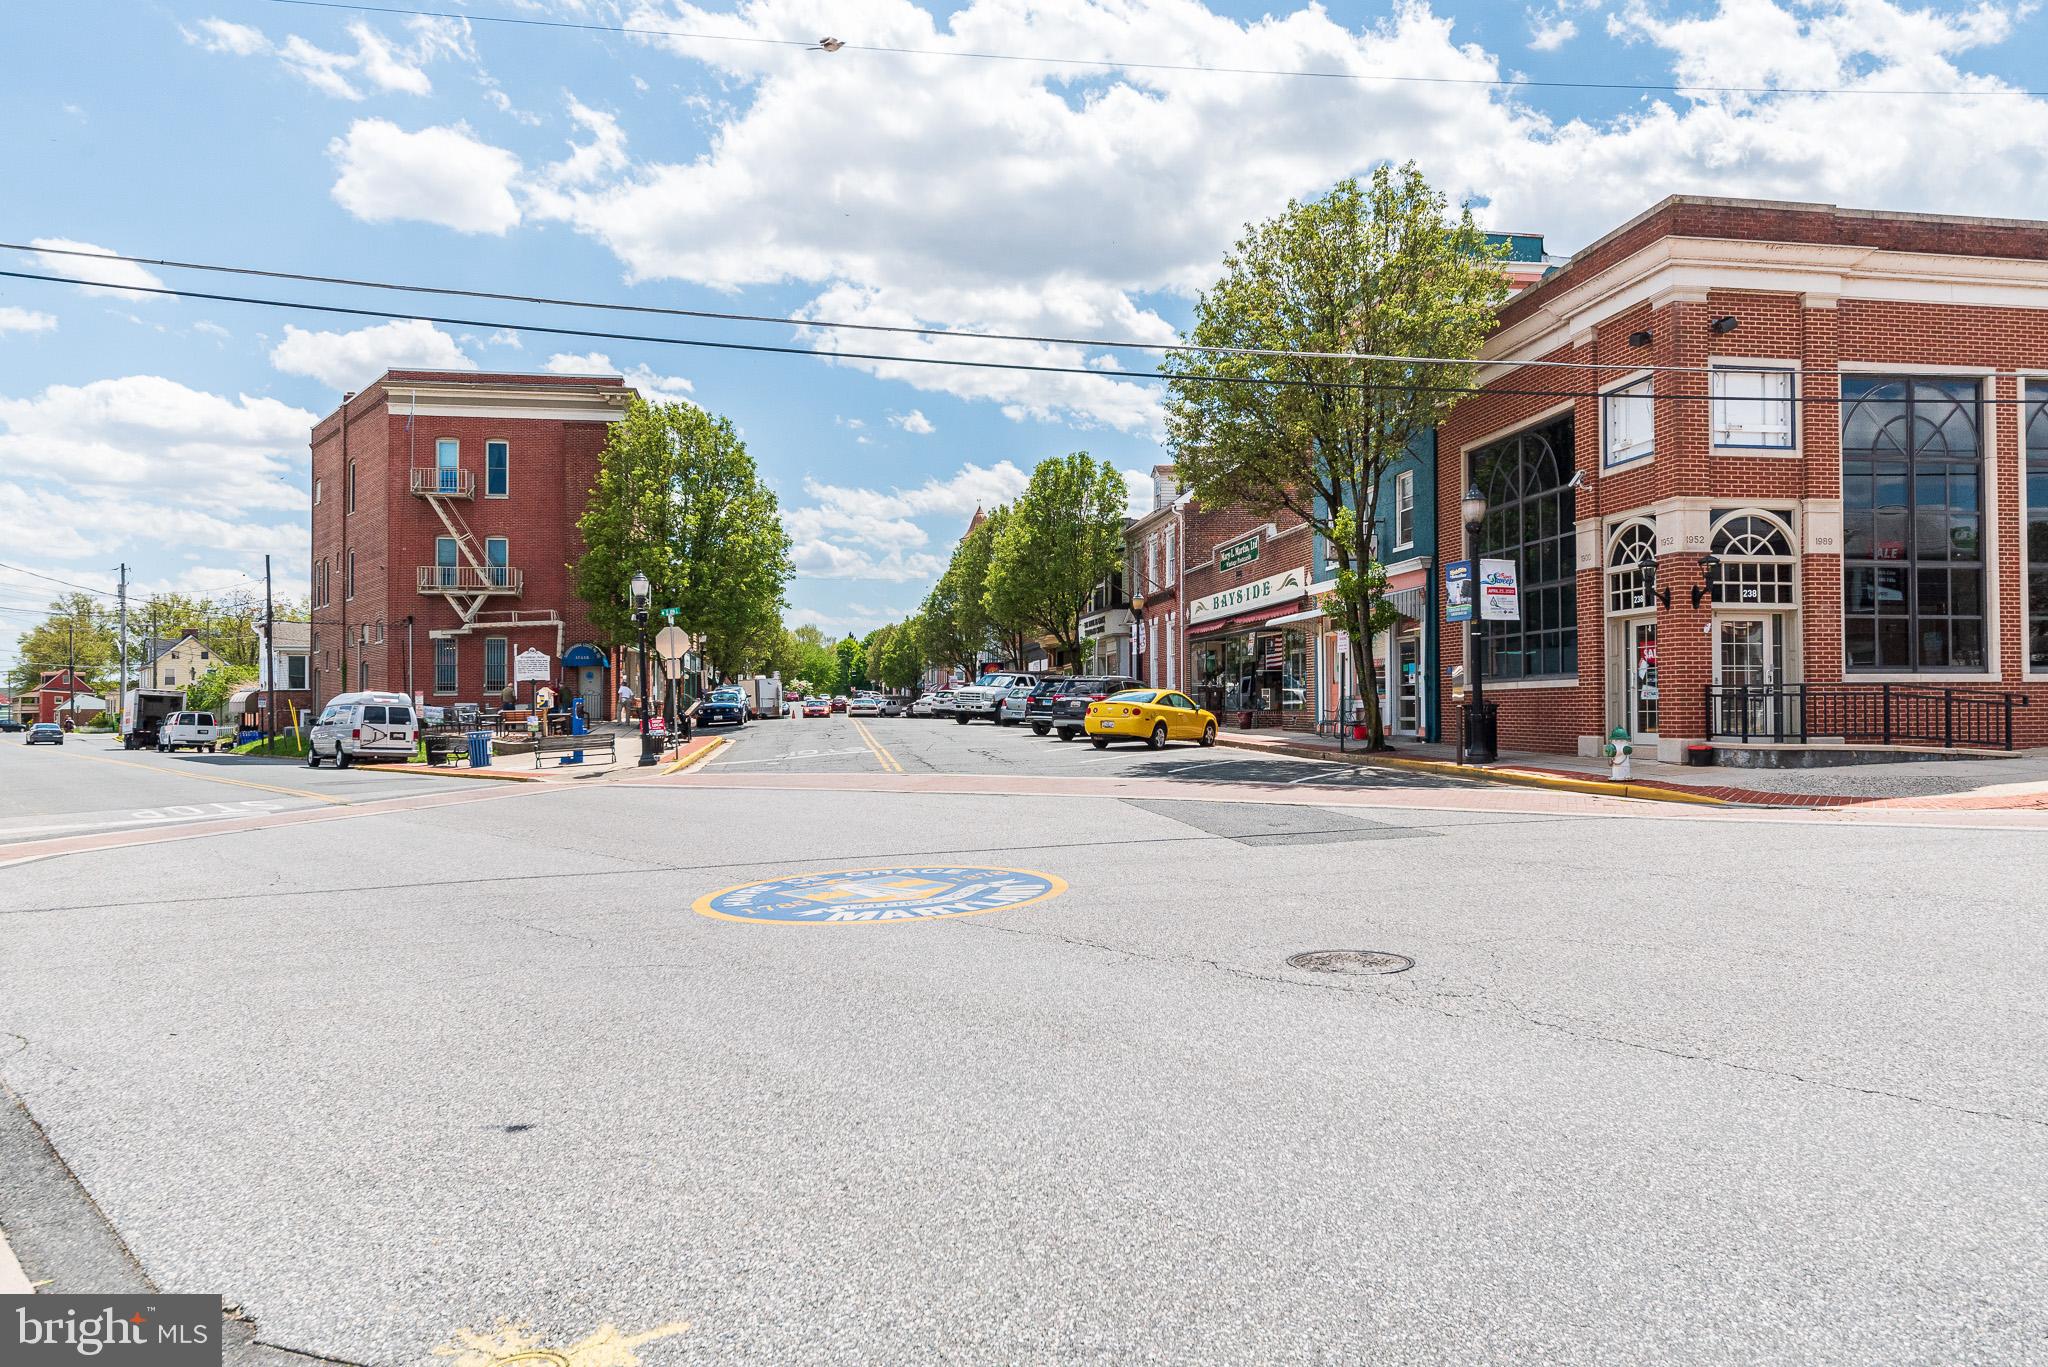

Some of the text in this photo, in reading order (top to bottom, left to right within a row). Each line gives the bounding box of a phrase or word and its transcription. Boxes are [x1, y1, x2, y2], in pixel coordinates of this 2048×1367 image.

[1661, 536, 1675, 546] 1952
[1686, 535, 1705, 544] 1952
[1815, 537, 1833, 546] 1989
[1213, 580, 1271, 610] BAYSIDE
[1743, 589, 1757, 598] 238
[1643, 648, 1657, 660] SAL
